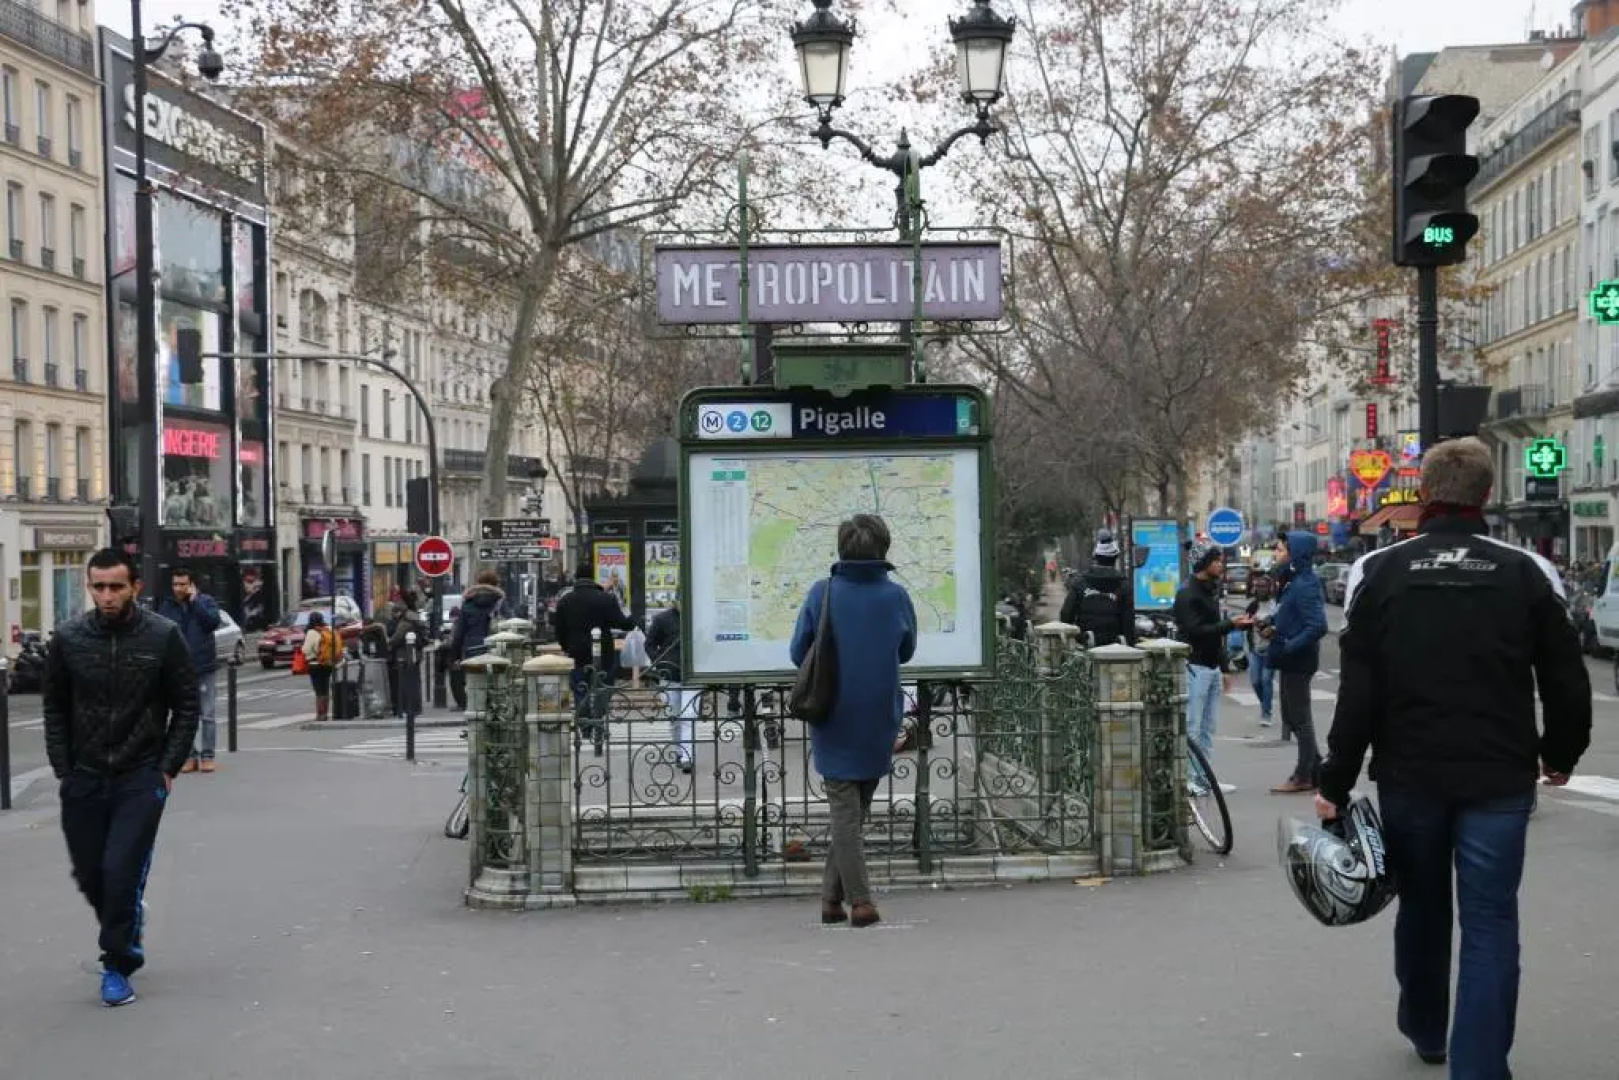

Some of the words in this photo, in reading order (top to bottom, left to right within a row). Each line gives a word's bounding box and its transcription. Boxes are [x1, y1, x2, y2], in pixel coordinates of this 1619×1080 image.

[1423, 227, 1454, 243] BUS
[672, 258, 987, 307] METROPOLITAIN
[752, 414, 770, 428] 12
[799, 407, 886, 435] Pigalle
